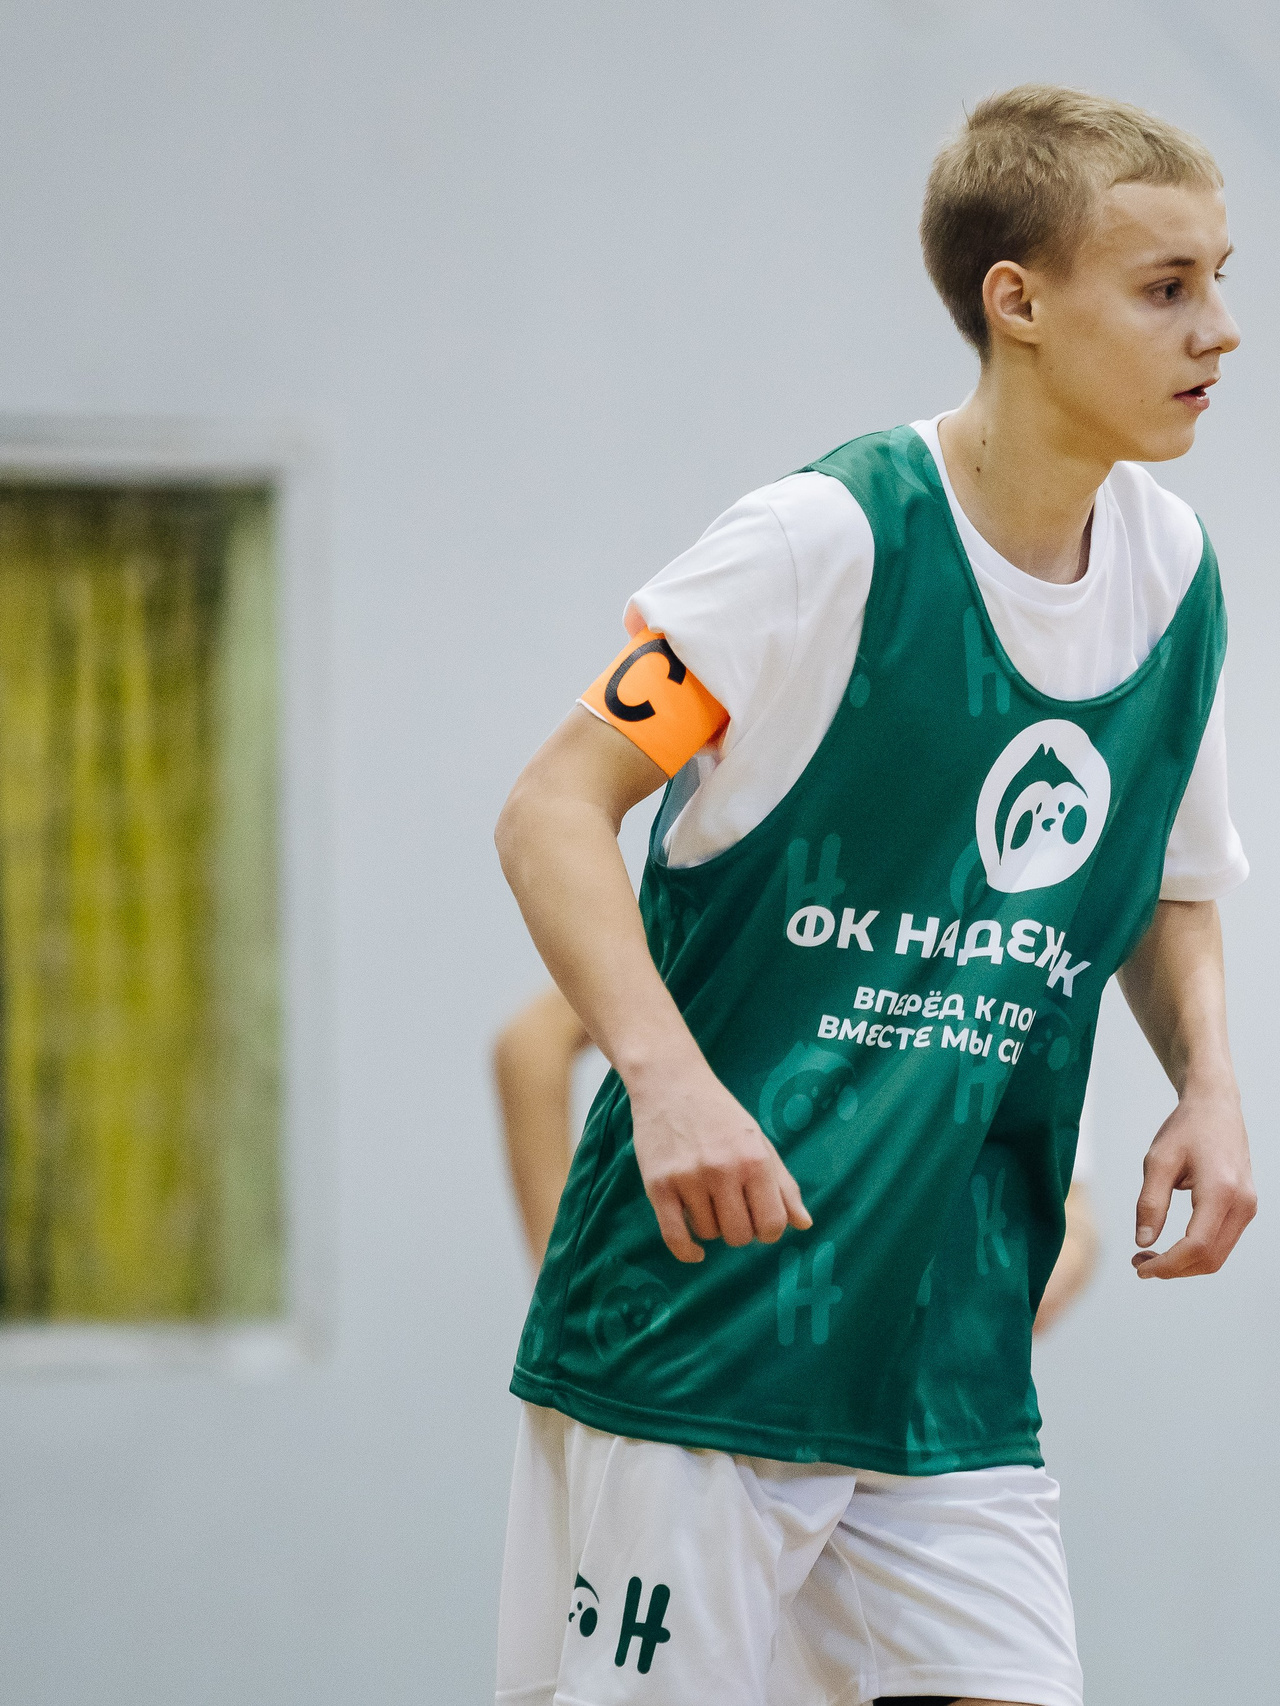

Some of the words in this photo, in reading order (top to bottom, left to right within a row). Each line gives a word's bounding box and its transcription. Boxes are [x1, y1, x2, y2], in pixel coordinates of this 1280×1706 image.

[604, 638, 687, 722] C
[786, 905, 880, 952] ФК
[853, 986, 965, 1021] ВПЕРЁД
[974, 995, 997, 1022] К
[998, 1001, 1037, 1032] ПО
[817, 1014, 934, 1050] ВМЕСТЕ
[940, 1025, 993, 1058] МЫ
